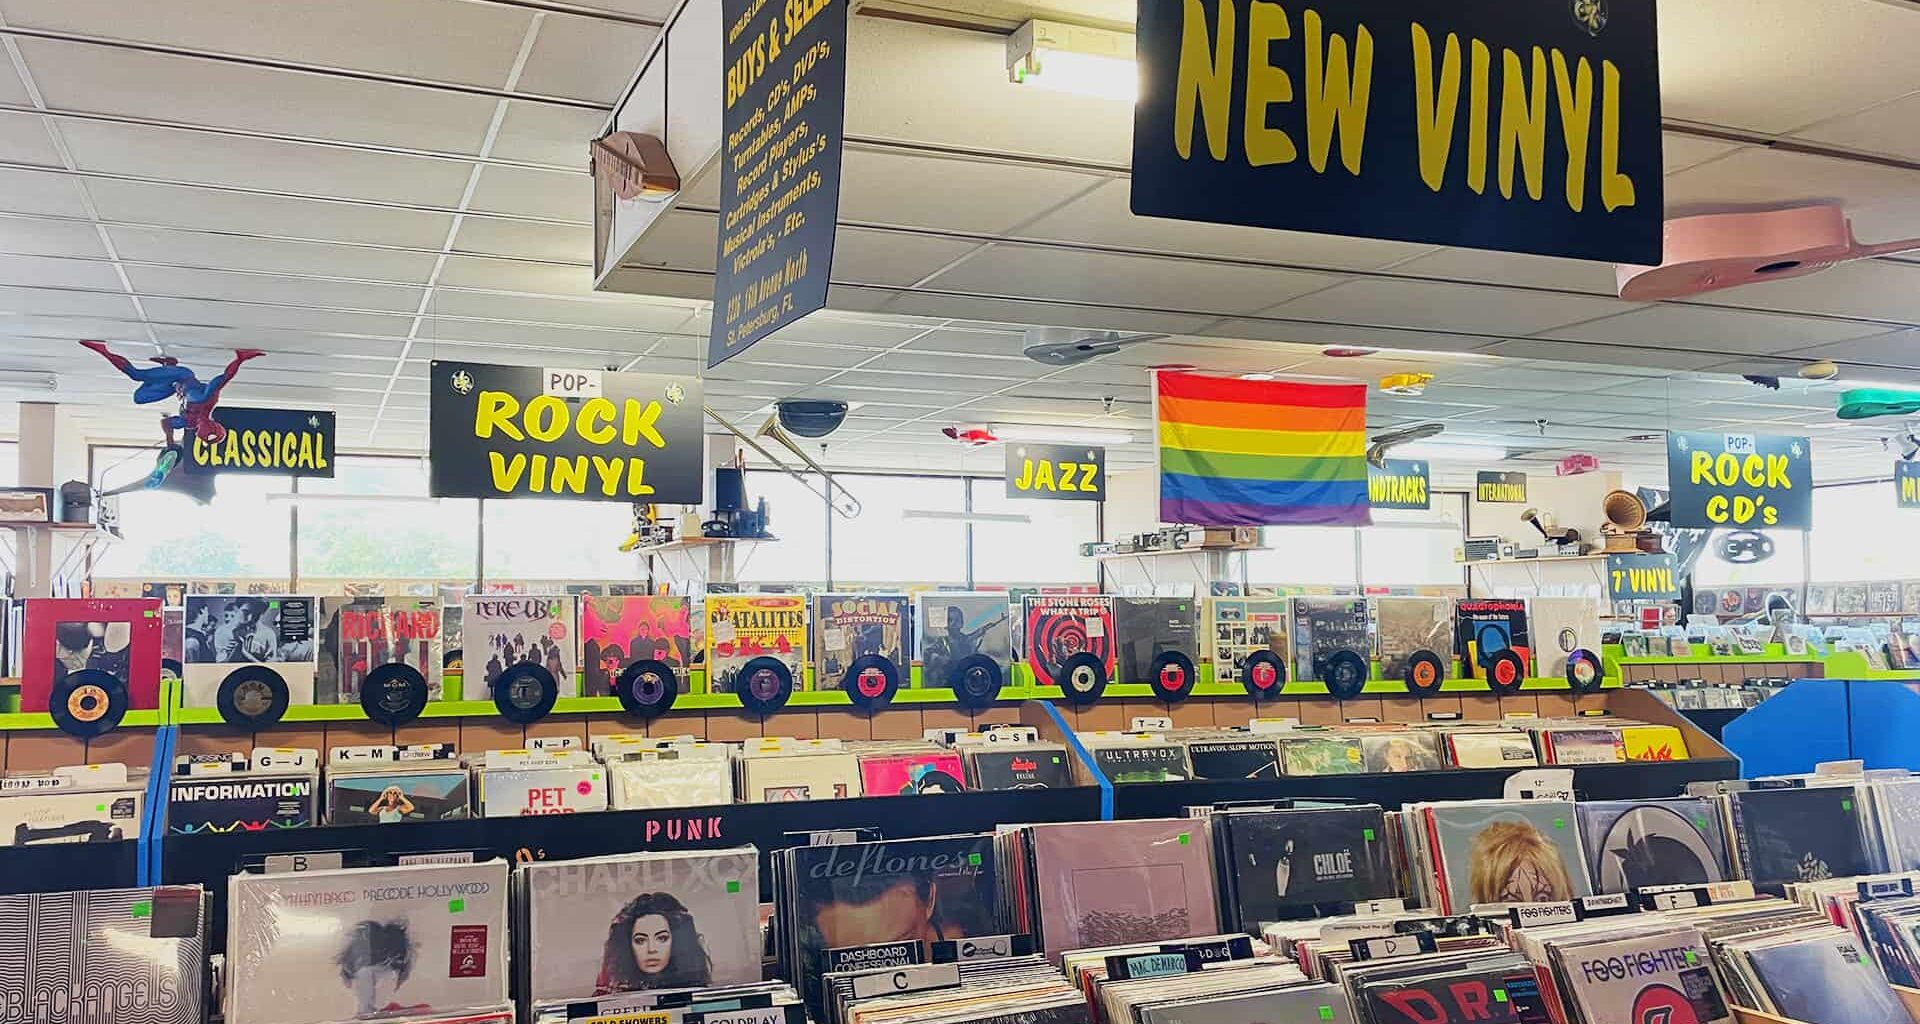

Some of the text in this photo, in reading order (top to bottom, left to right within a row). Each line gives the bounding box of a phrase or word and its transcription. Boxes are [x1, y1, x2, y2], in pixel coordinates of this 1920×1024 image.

[727, 0, 833, 110] BUYS & SEL
[728, 40, 831, 154] Records, CD's, DVD's,
[1174, 0, 1636, 213] NEW VINYL
[734, 118, 781, 172] Turntables,
[737, 121, 809, 197] Record Players,
[725, 182, 770, 231] Cartridges
[771, 169, 779, 191] &
[723, 169, 822, 258] Musical Instruments,
[784, 211, 806, 237] Etc.
[782, 291, 794, 315] FL
[549, 373, 596, 391] POP-
[475, 390, 664, 448] ROCK
[193, 429, 328, 469] CLASSICAL
[489, 451, 655, 497] VINYL
[1014, 458, 1099, 493] JAZZ
[1690, 450, 1792, 490] ROCK
[1478, 483, 1526, 502] INTERNATIONAL
[1902, 475, 1920, 503] M
[1706, 494, 1778, 526] CD's
[1628, 566, 1677, 594] VINYL
[832, 601, 898, 616] SOCIAL
[1080, 596, 1111, 606] ROSES
[342, 610, 440, 640] RICHARD
[835, 616, 896, 625] DISTORTION
[534, 740, 543, 749] N
[563, 739, 570, 748] P
[1013, 733, 1020, 742] S
[260, 757, 271, 766] G
[294, 756, 303, 766] J
[339, 750, 350, 760] K
[371, 749, 383, 759] M
[1106, 749, 1176, 760] ULTRAVOX
[171, 782, 310, 803] INFORMATION
[528, 787, 566, 808] PET
[645, 816, 722, 843] PUNK
[293, 856, 309, 872] B
[809, 843, 964, 888] deftones
[1313, 848, 1353, 876] CHLOË
[418, 882, 490, 898] HOLLYWOOD
[1538, 905, 1572, 917] FIGHTERS
[839, 946, 908, 964] DASHBOARD
[1385, 940, 1397, 954] D
[1129, 956, 1186, 976] MAC DEMARCO
[1582, 945, 1699, 984] FOO FIGHTE
[893, 972, 909, 990] C
